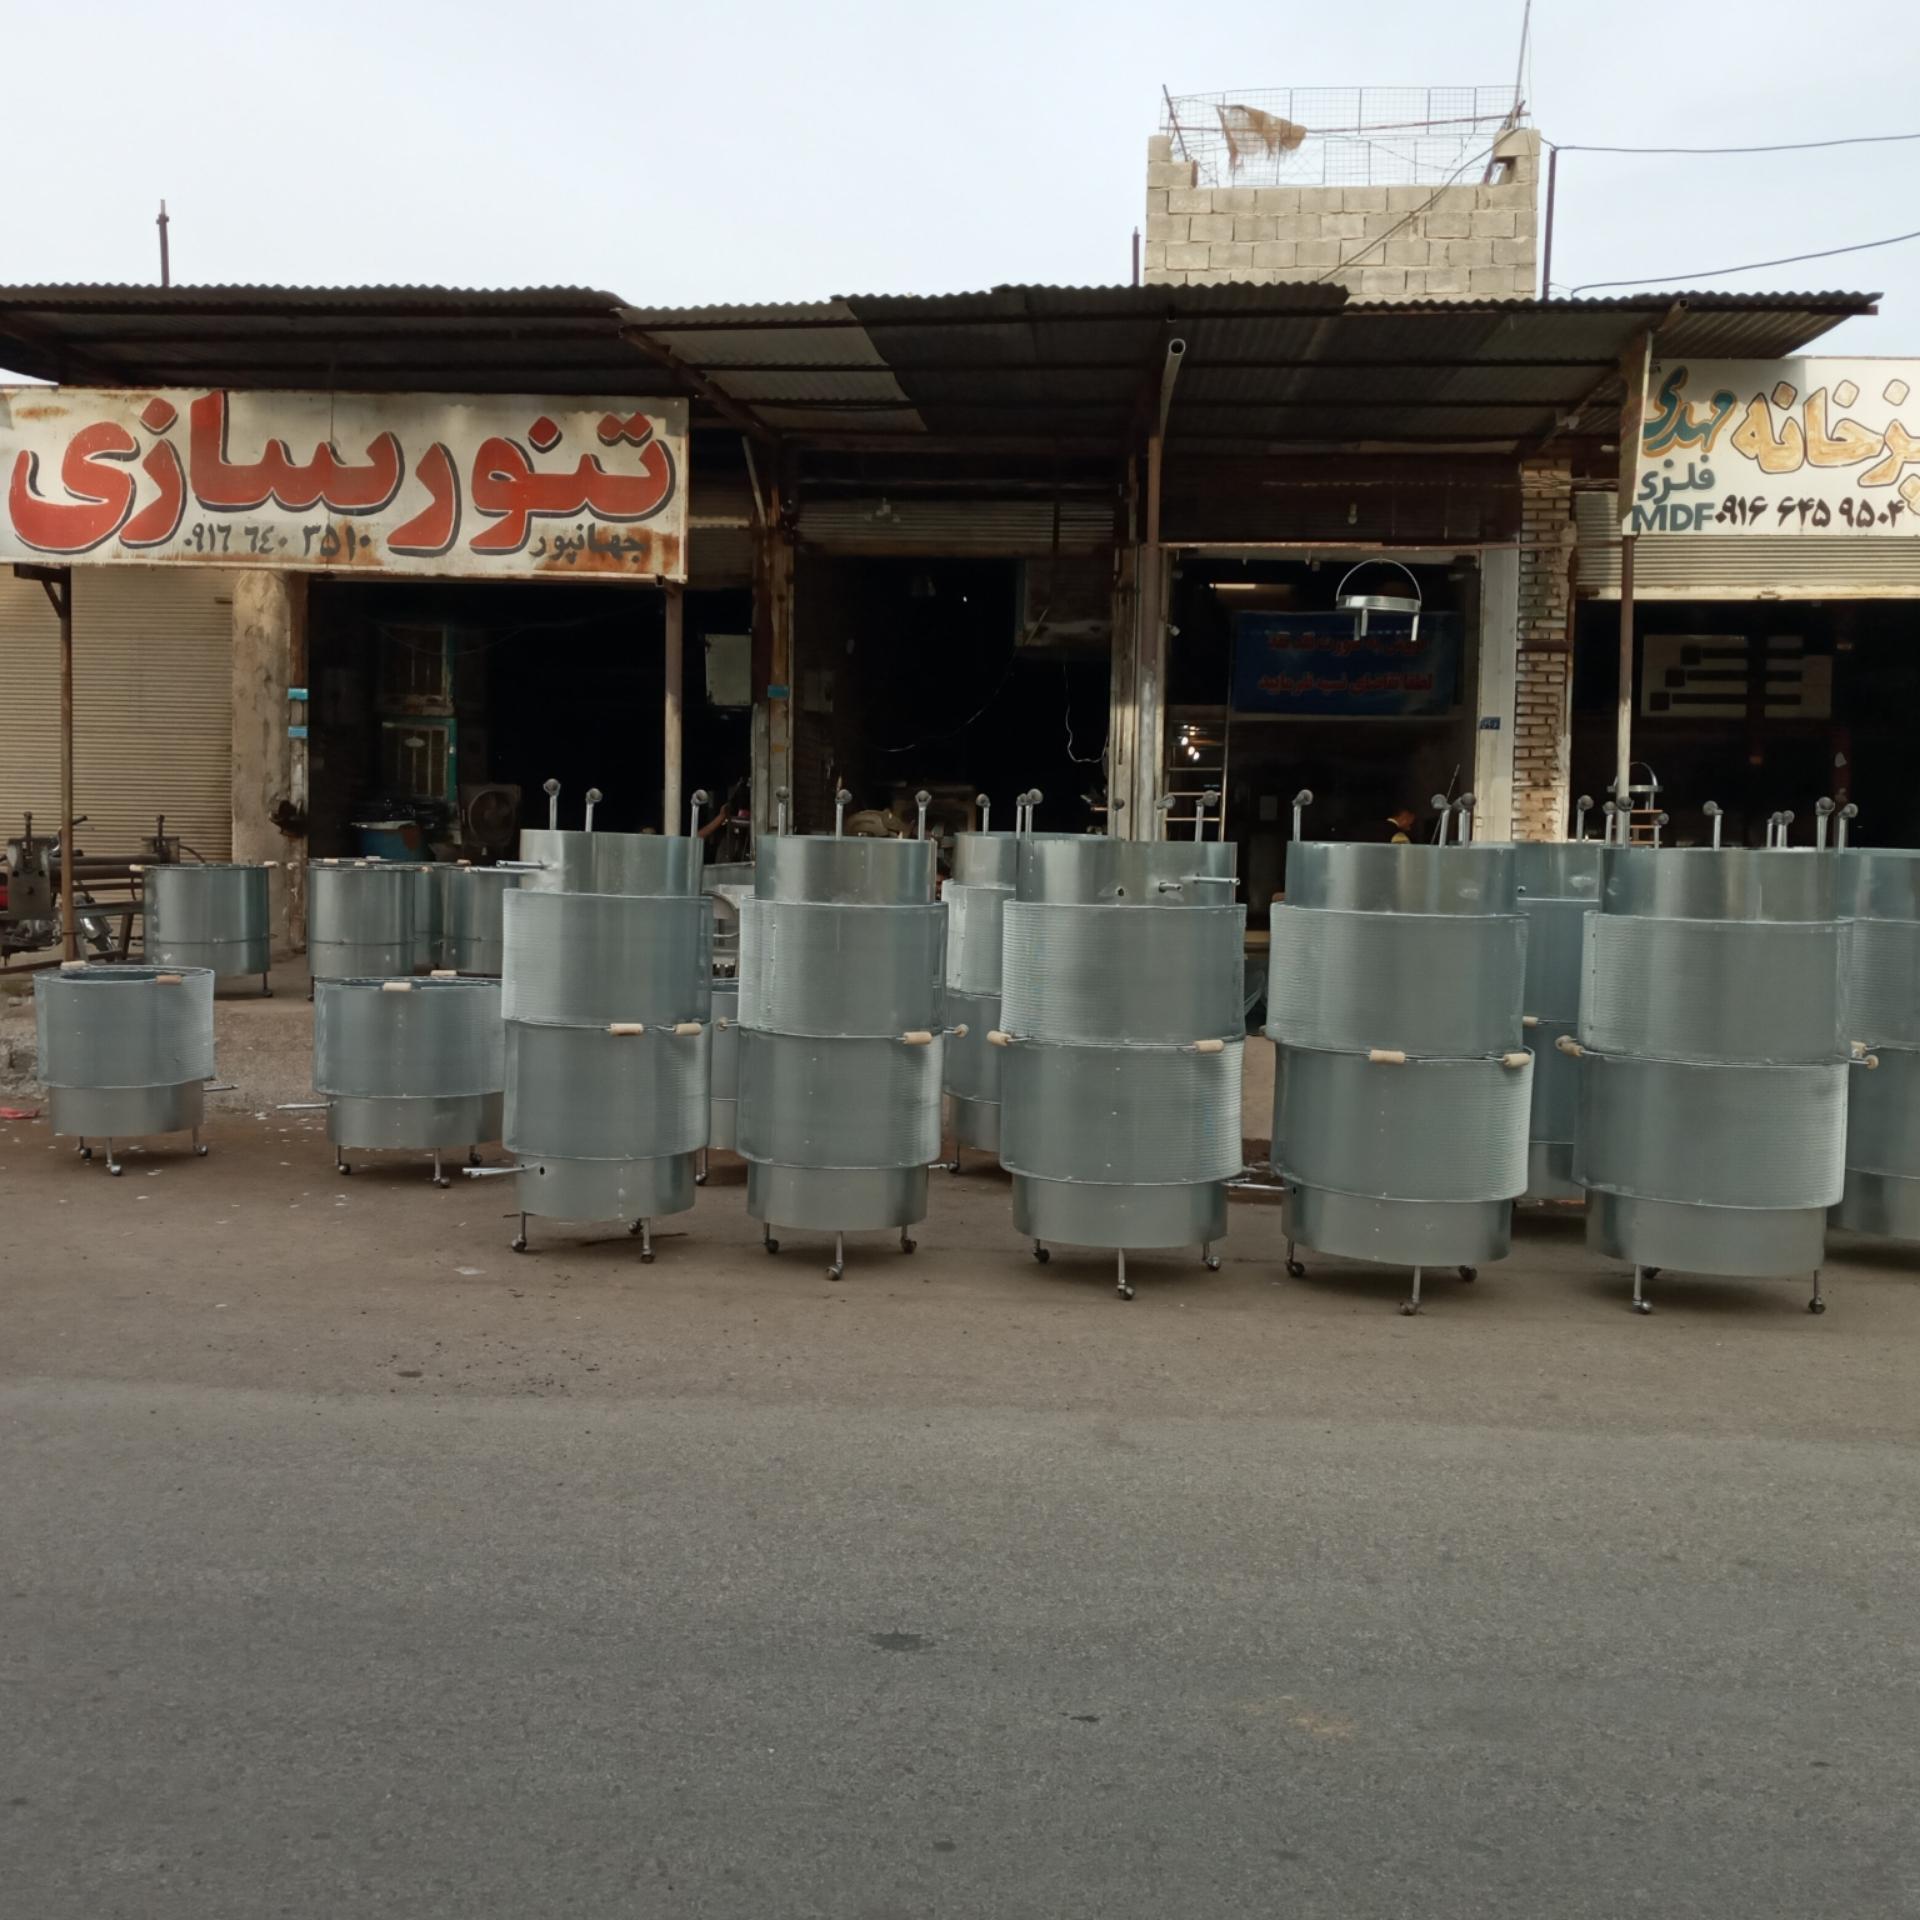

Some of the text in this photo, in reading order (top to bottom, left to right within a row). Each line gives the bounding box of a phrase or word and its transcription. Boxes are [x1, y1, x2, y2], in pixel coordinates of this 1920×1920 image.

[1642, 365, 1737, 458] مهدی
[1637, 454, 1716, 505] فلزی
[1631, 502, 1715, 532] MDF
[528, 523, 647, 564] جهانپور
